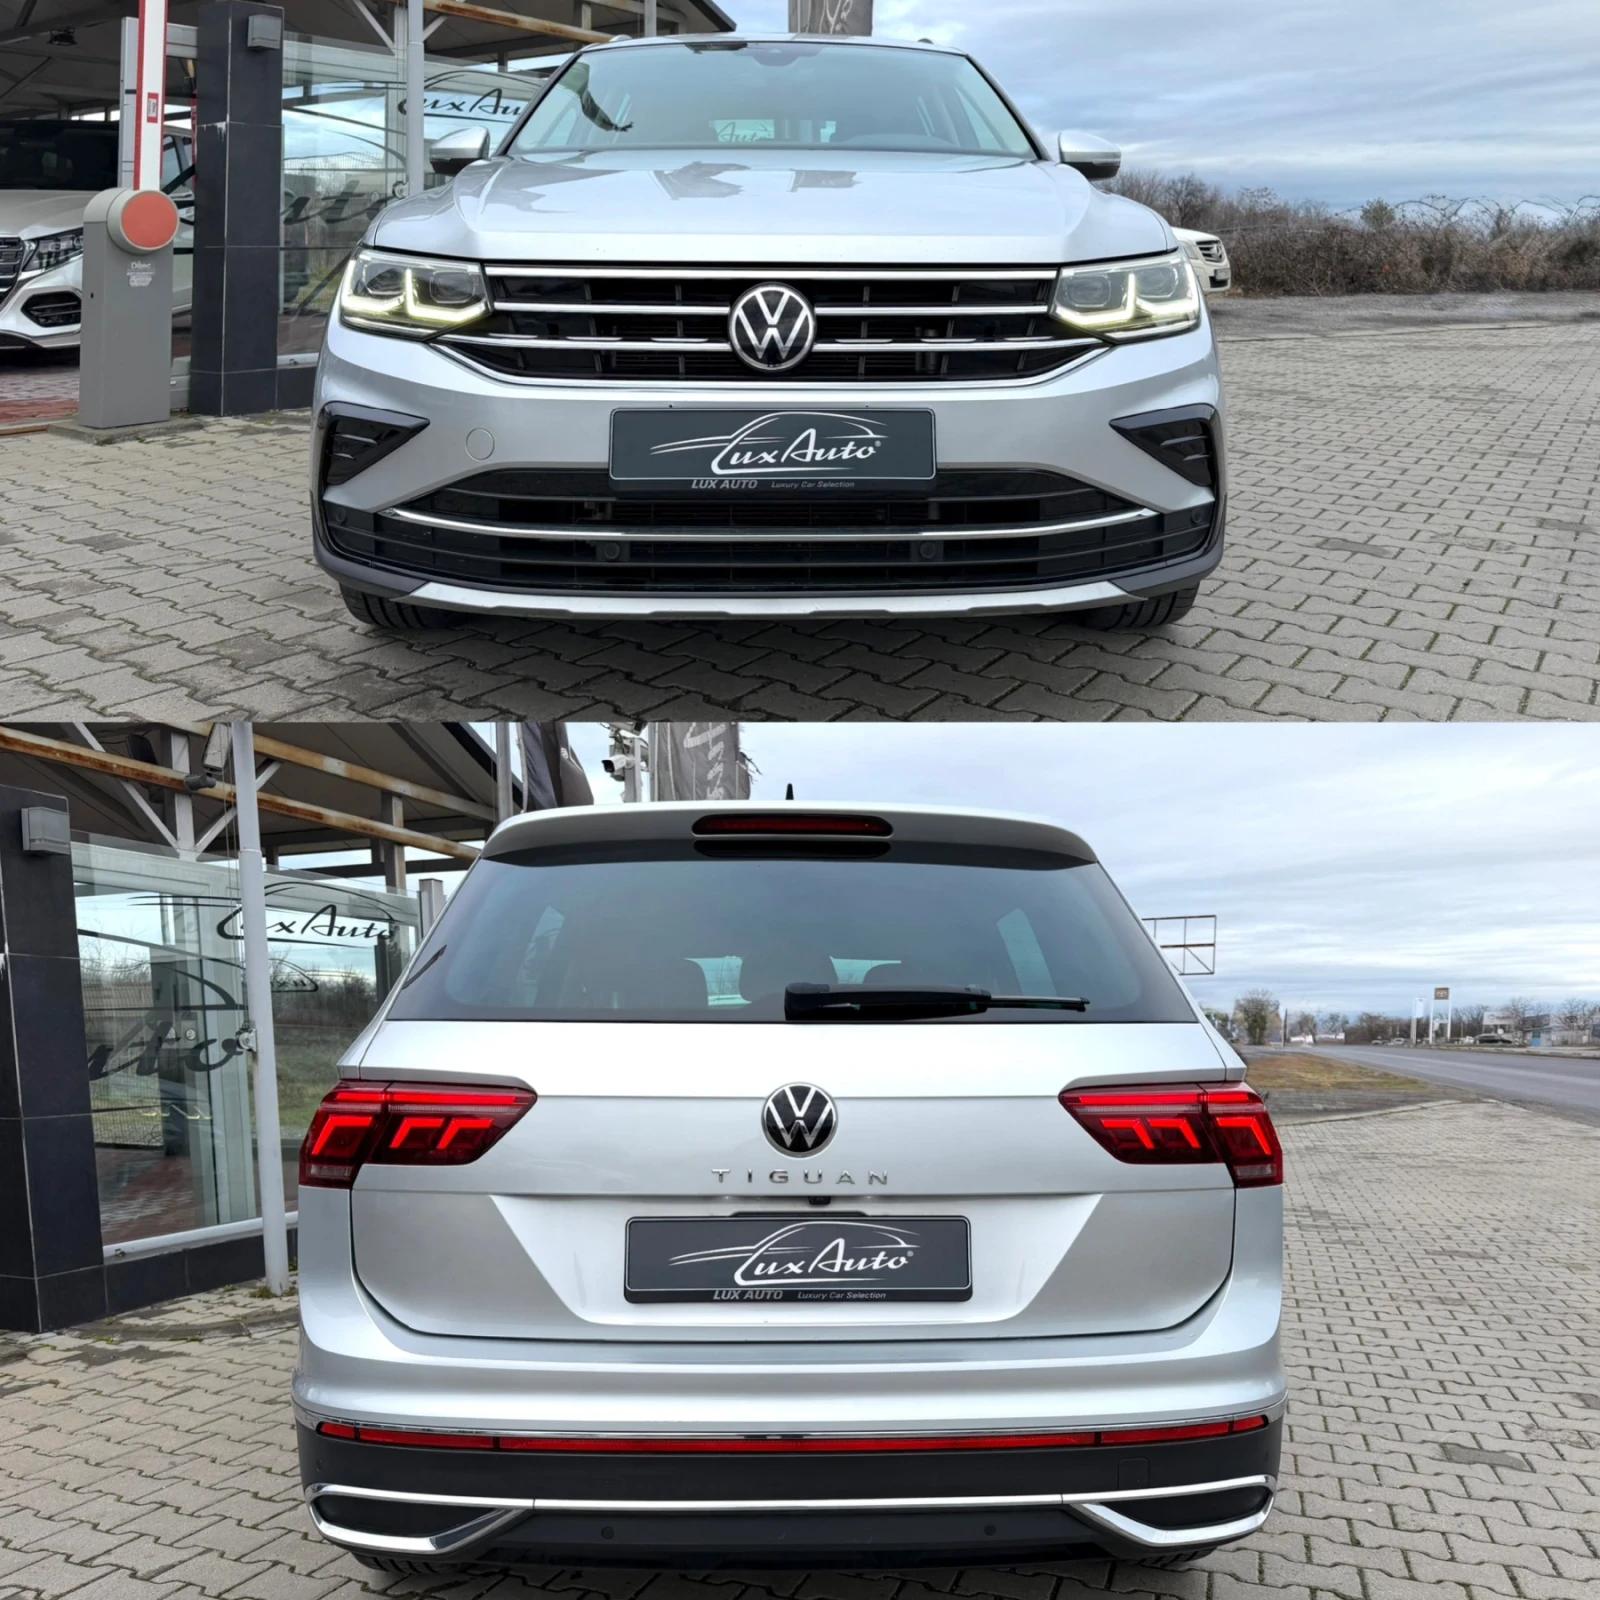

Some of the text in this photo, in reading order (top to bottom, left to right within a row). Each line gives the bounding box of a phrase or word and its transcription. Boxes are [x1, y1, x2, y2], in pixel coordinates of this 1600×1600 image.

[732, 287, 812, 366] VW
[691, 479, 717, 489] LUX
[720, 479, 758, 489] AUTO
[771, 481, 799, 489] Luxury
[763, 1085, 836, 1154] VW
[711, 1169, 889, 1185] TIGUAN
[713, 1290, 886, 1300] LUX AUTO Luxury Car Selection
